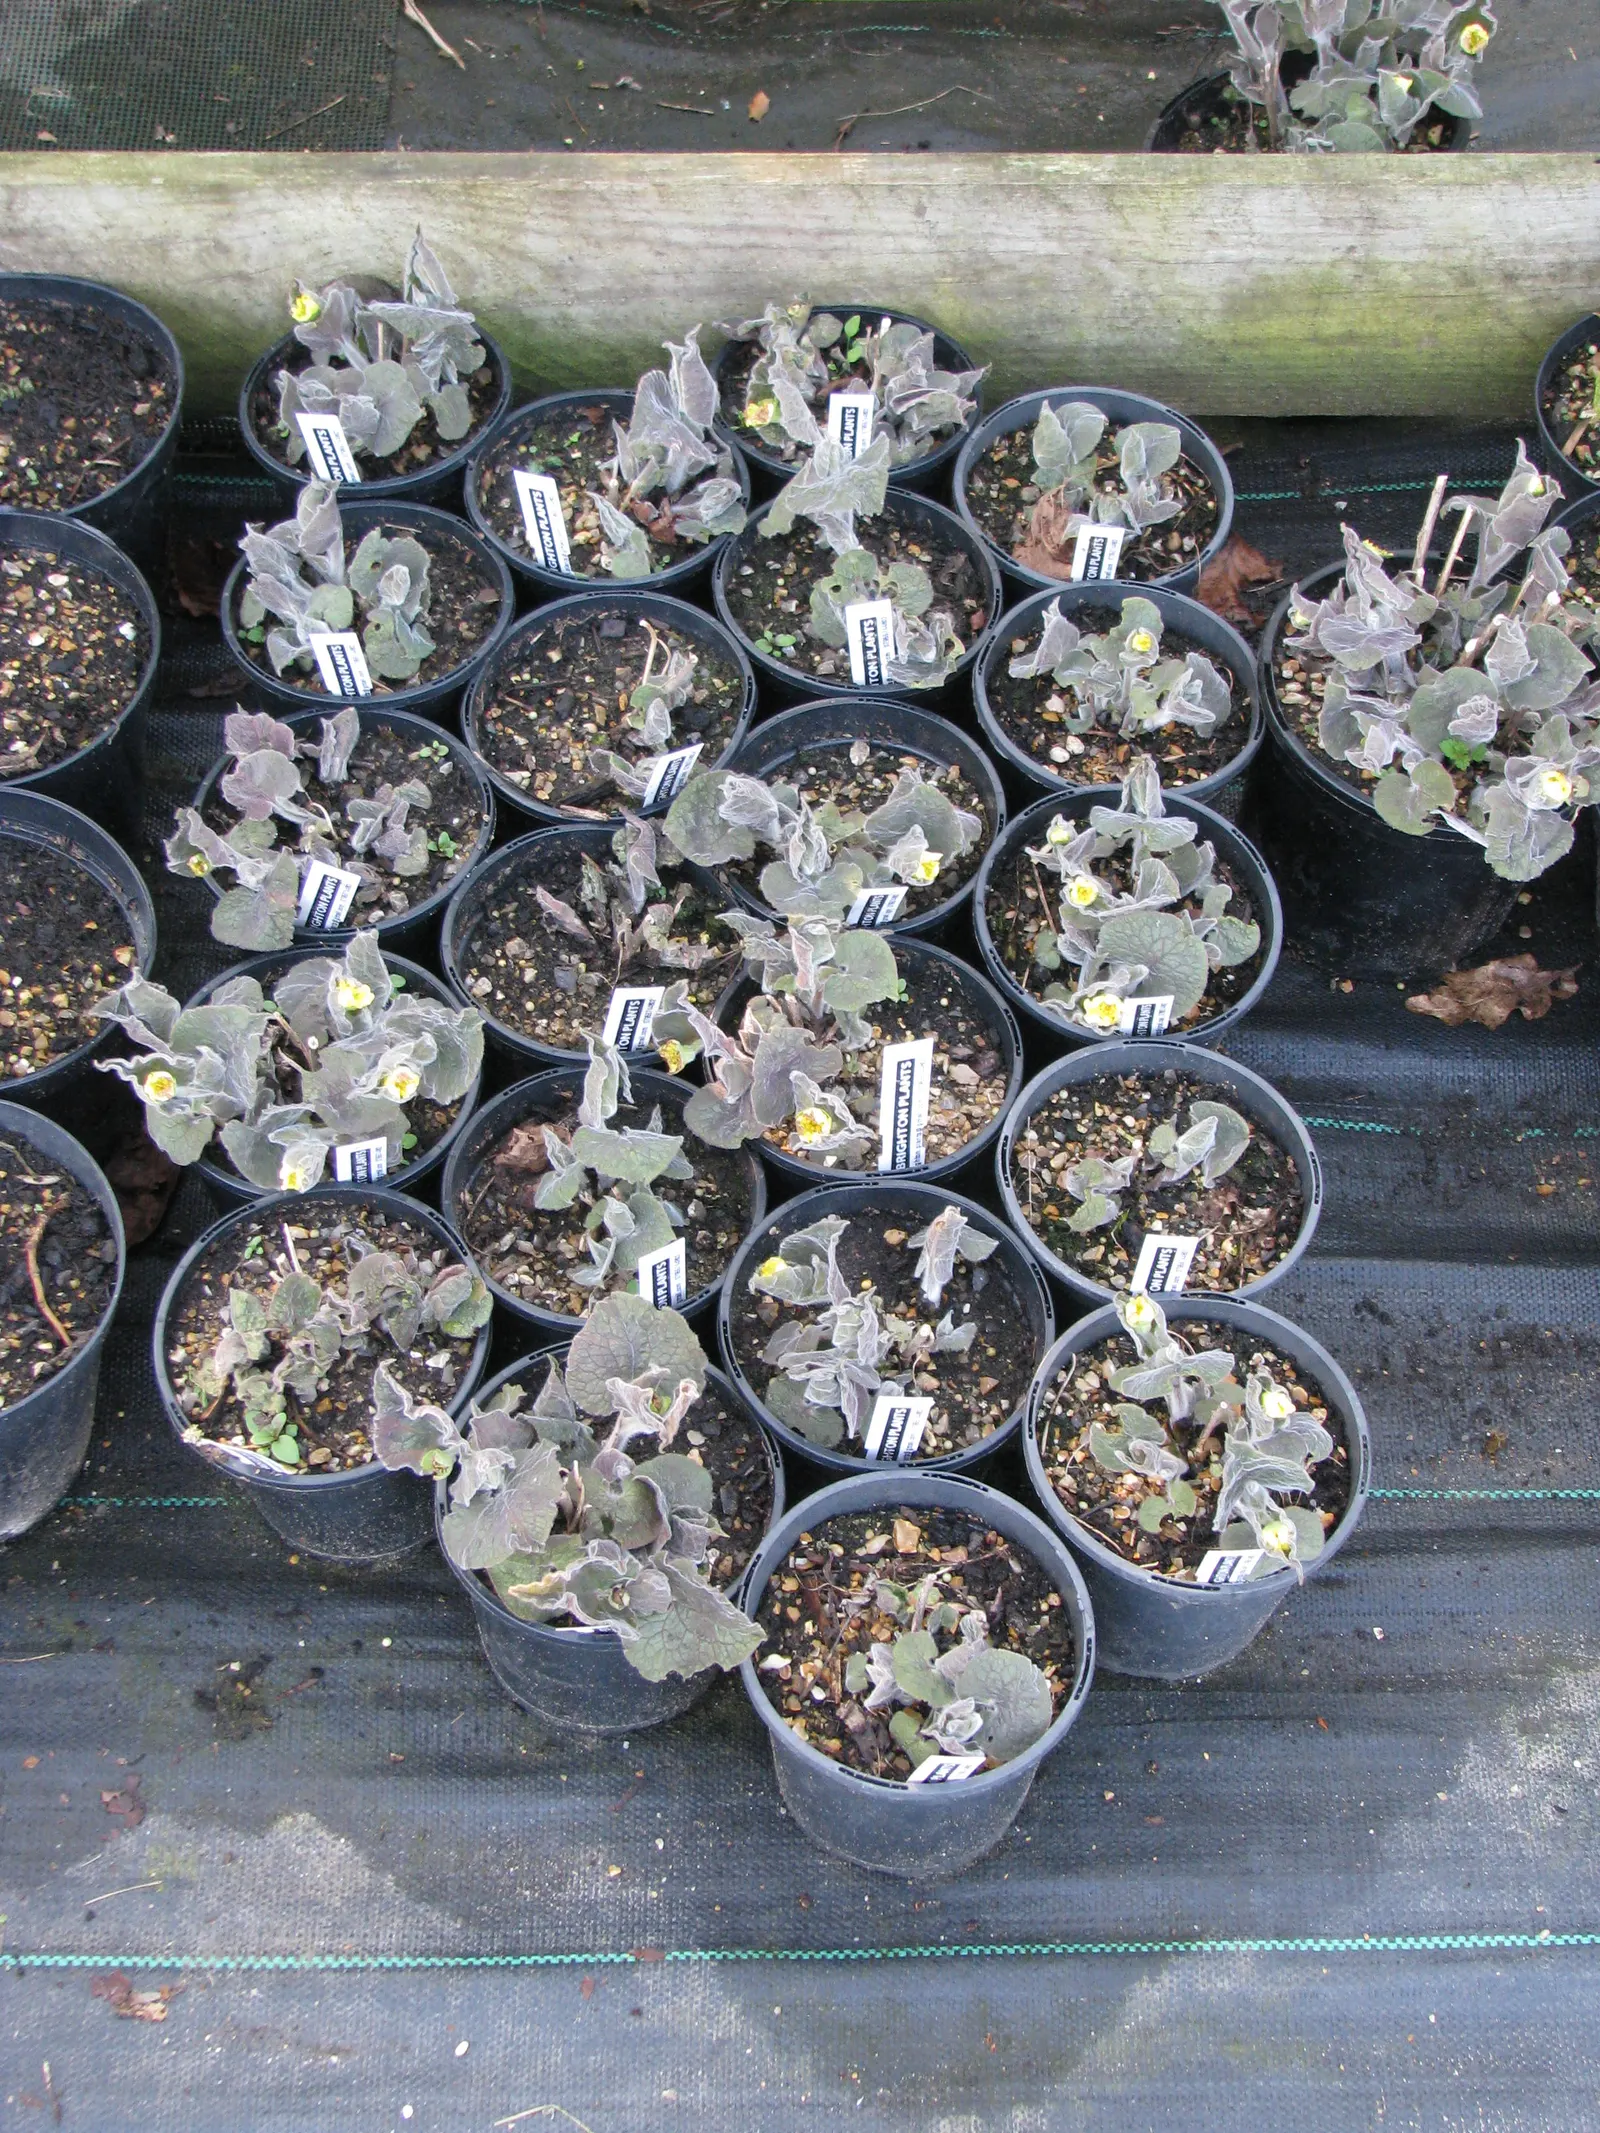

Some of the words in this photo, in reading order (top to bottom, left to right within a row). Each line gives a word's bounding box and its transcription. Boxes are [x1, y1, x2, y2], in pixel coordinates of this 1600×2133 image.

[843, 407, 857, 442] PLANTS
[316, 429, 339, 466] PLANTS
[531, 489, 550, 531] PLANTS
[1089, 536, 1105, 566] PLANTS
[1086, 566, 1099, 580] ON
[863, 618, 877, 660] PLANTS
[331, 644, 350, 674] PLANTS
[319, 877, 338, 903] PLANTS
[622, 1000, 641, 1032] PLANTS
[898, 1060, 912, 1107] PLANTS
[895, 1107, 909, 1170] BRIGHTON
[656, 1260, 668, 1297] PLANTS
[1152, 1248, 1173, 1279] PLANTS
[887, 1408, 908, 1436] PLANTS
